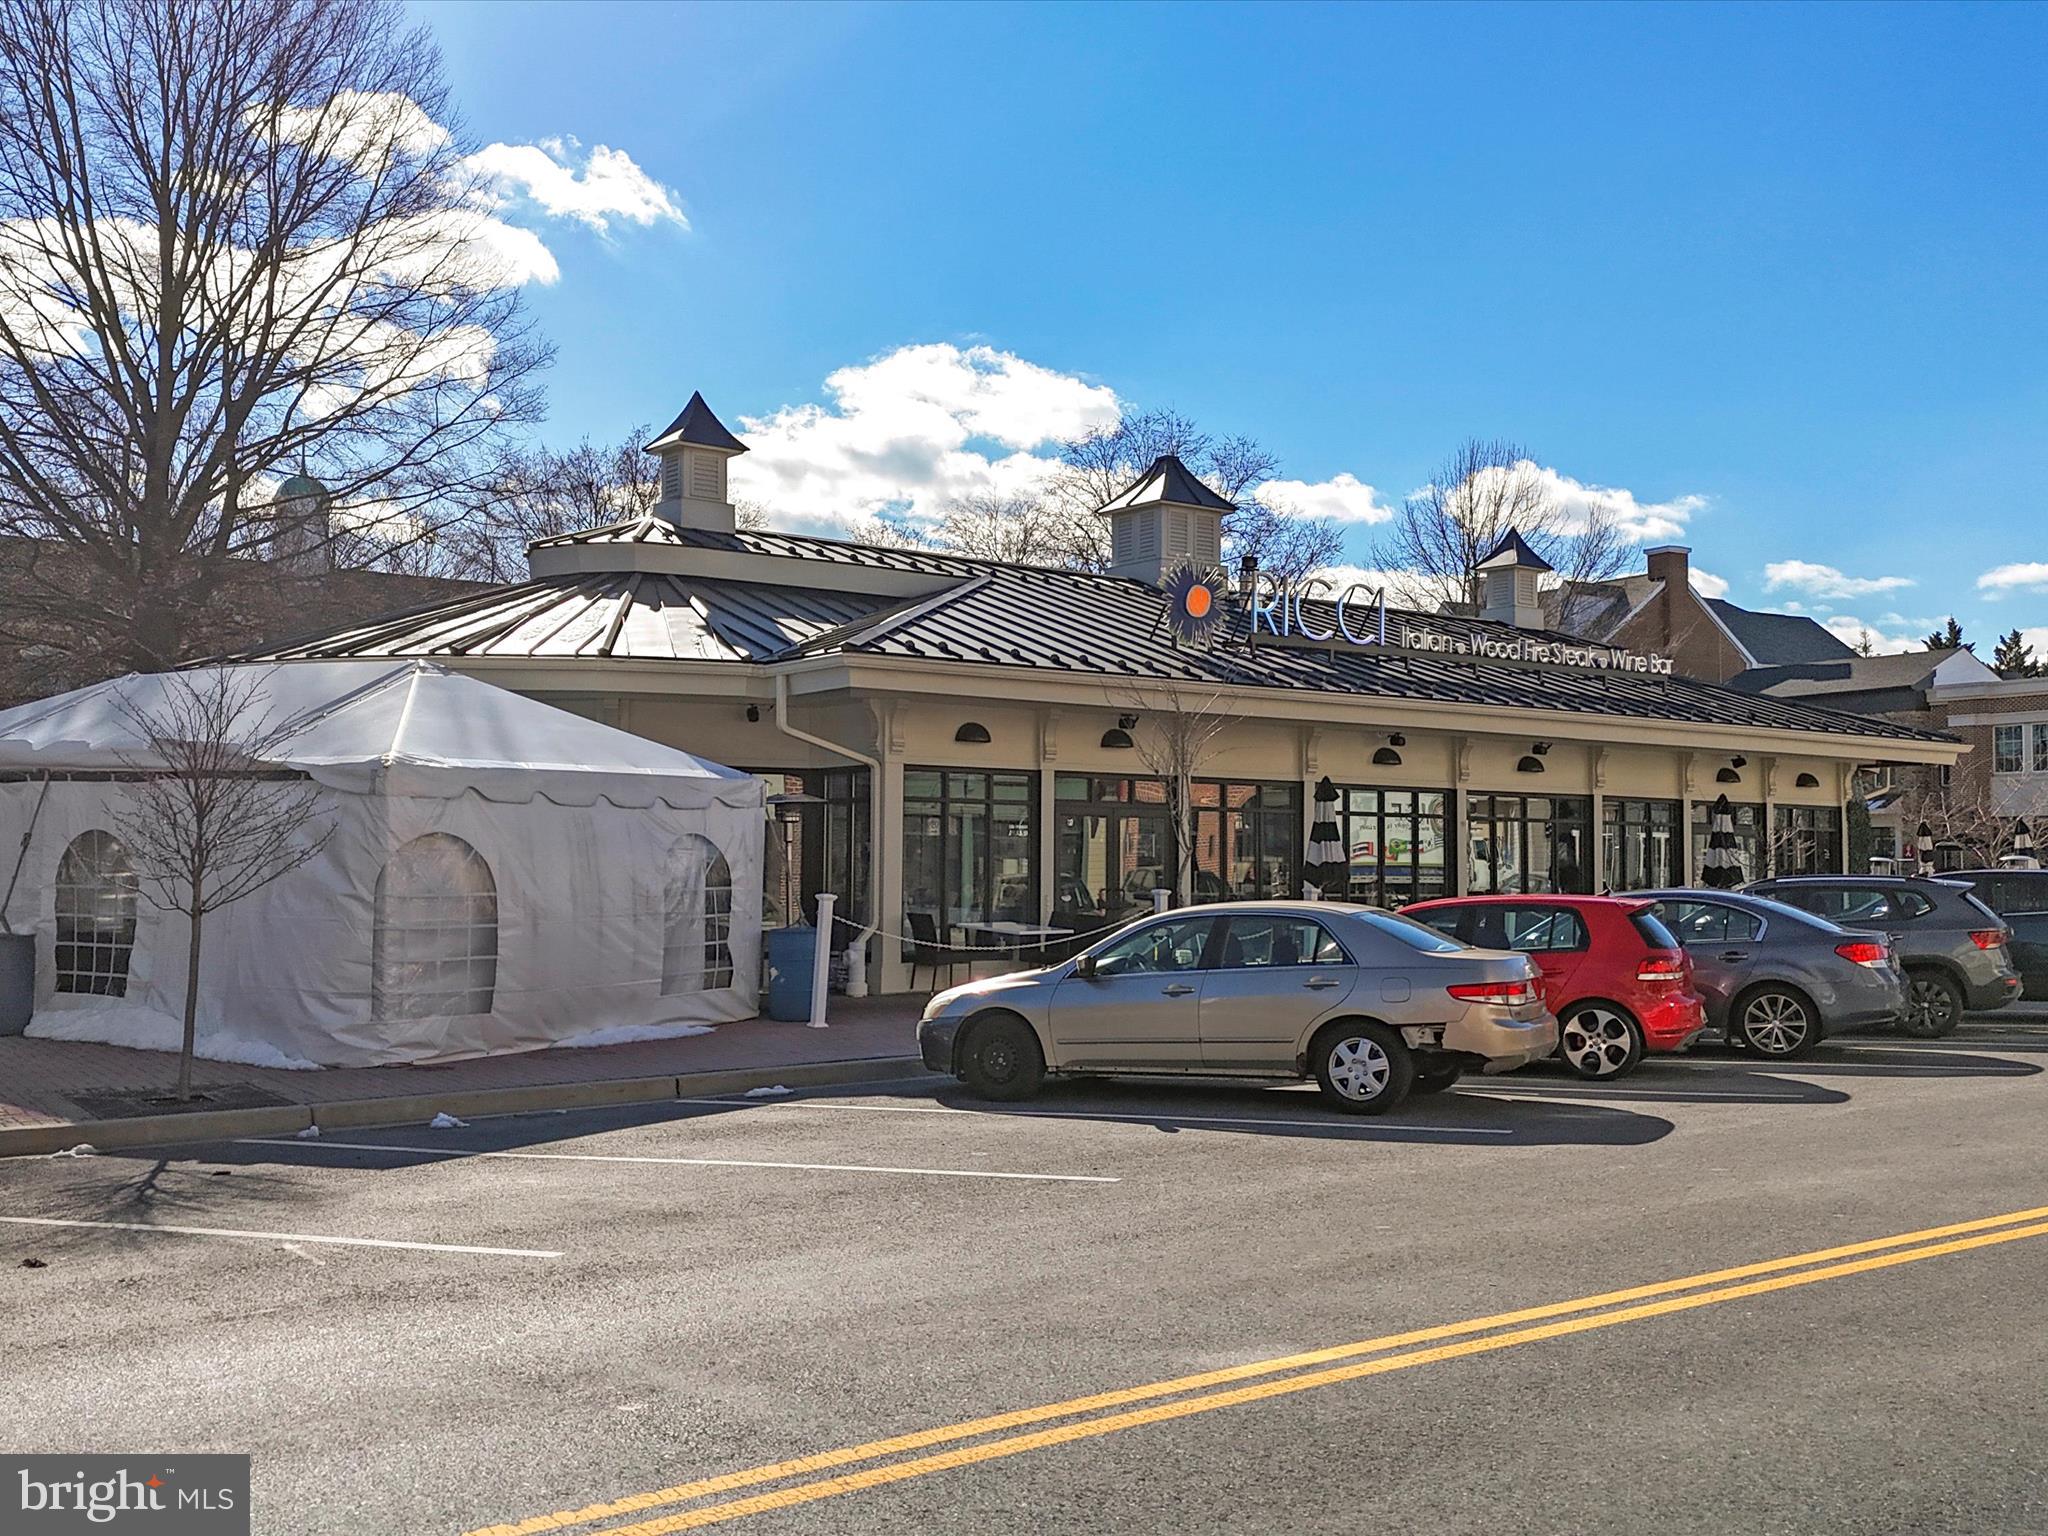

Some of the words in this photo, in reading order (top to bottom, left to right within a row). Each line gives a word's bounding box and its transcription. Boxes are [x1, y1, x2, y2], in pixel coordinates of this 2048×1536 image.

[1251, 571, 1385, 646] RICCI
[1401, 625, 1453, 653] Italian
[1470, 632, 1521, 660] Wood
[1611, 648, 1648, 672] Wine
[1650, 653, 1673, 675] Bar
